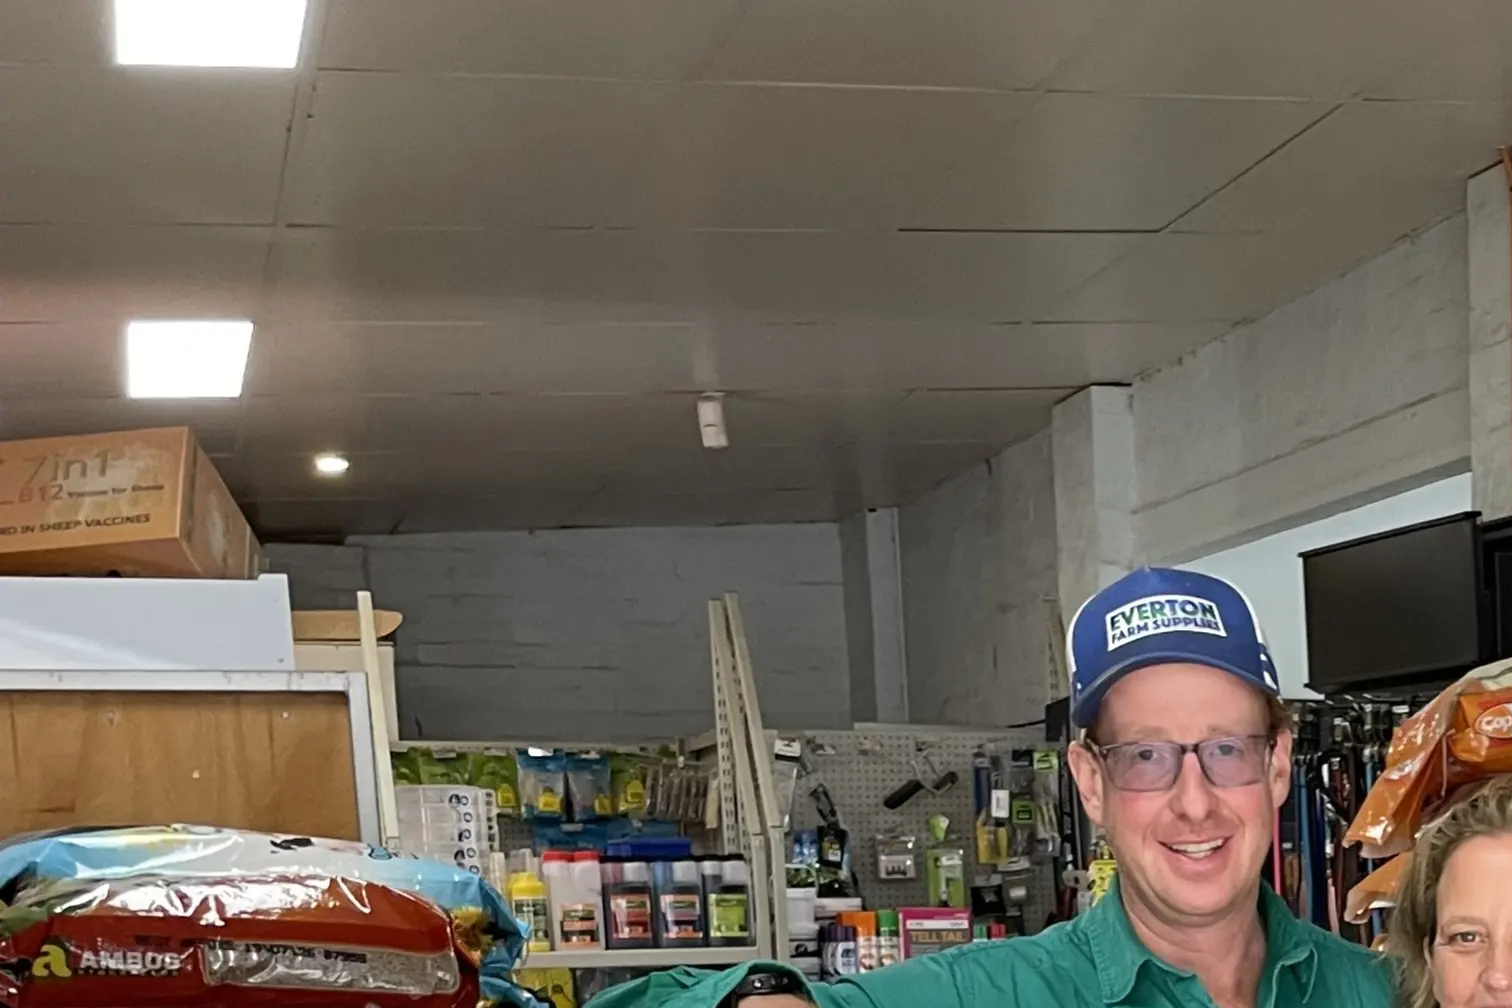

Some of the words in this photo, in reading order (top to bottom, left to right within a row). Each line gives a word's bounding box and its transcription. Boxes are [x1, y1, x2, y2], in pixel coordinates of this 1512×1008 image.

[85, 513, 151, 528] VACCINES
[1111, 600, 1217, 631] EVERTON
[1111, 621, 1149, 644] FARM
[1153, 616, 1221, 632] SUPPLIES
